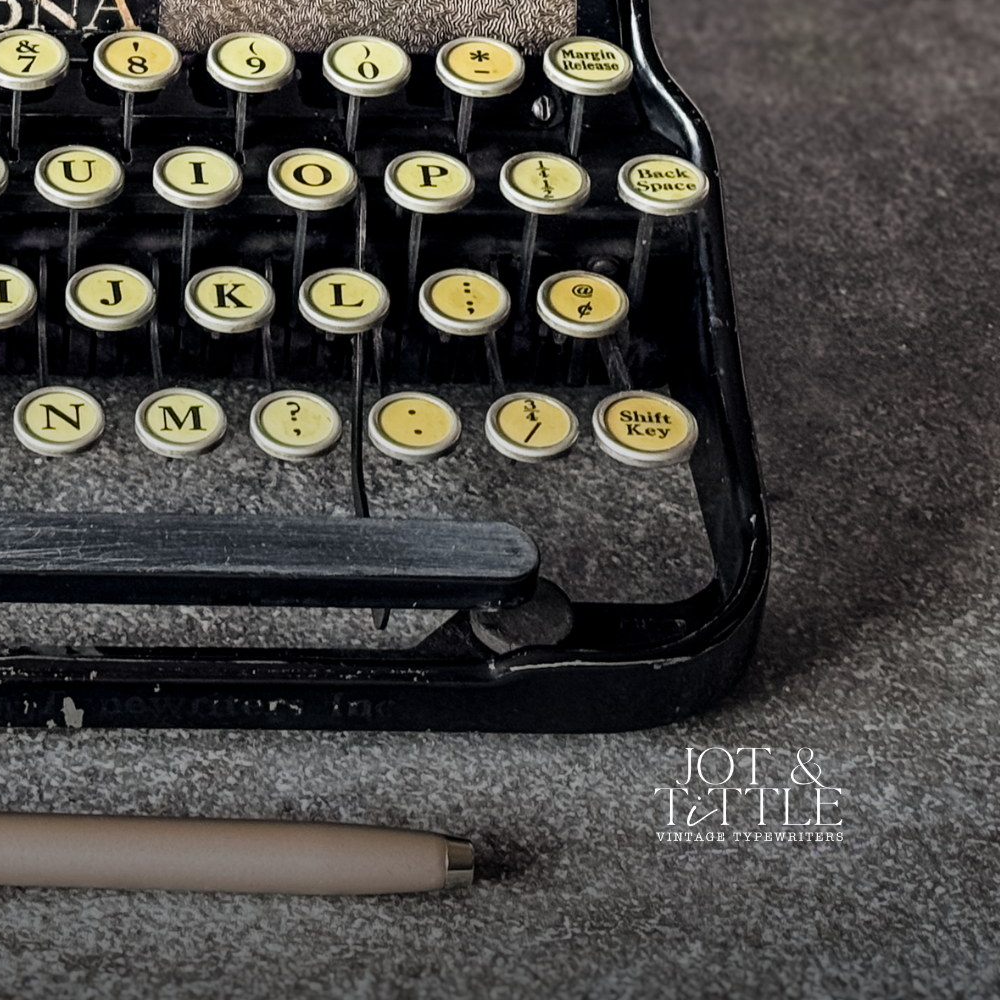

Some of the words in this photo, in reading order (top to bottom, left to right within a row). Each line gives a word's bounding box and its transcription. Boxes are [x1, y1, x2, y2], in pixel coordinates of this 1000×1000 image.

[15, 39, 40, 54] &
[561, 49, 616, 61] Margin
[17, 54, 37, 73] 7
[127, 55, 150, 75] 8
[245, 56, 267, 75] 9
[562, 60, 619, 71] Release
[61, 159, 96, 183] U
[188, 161, 209, 185] I
[292, 163, 333, 187] O
[416, 164, 449, 188] P
[637, 168, 691, 179] Back
[636, 181, 697, 193] Space
[99, 279, 124, 306] J
[213, 283, 252, 309] K
[328, 282, 364, 308] L
[571, 284, 594, 299] @
[39, 403, 85, 431] N
[158, 405, 207, 431] M
[286, 401, 301, 422] ?
[619, 410, 672, 424] Shift
[523, 421, 542, 444] /
[626, 424, 672, 439] Key
